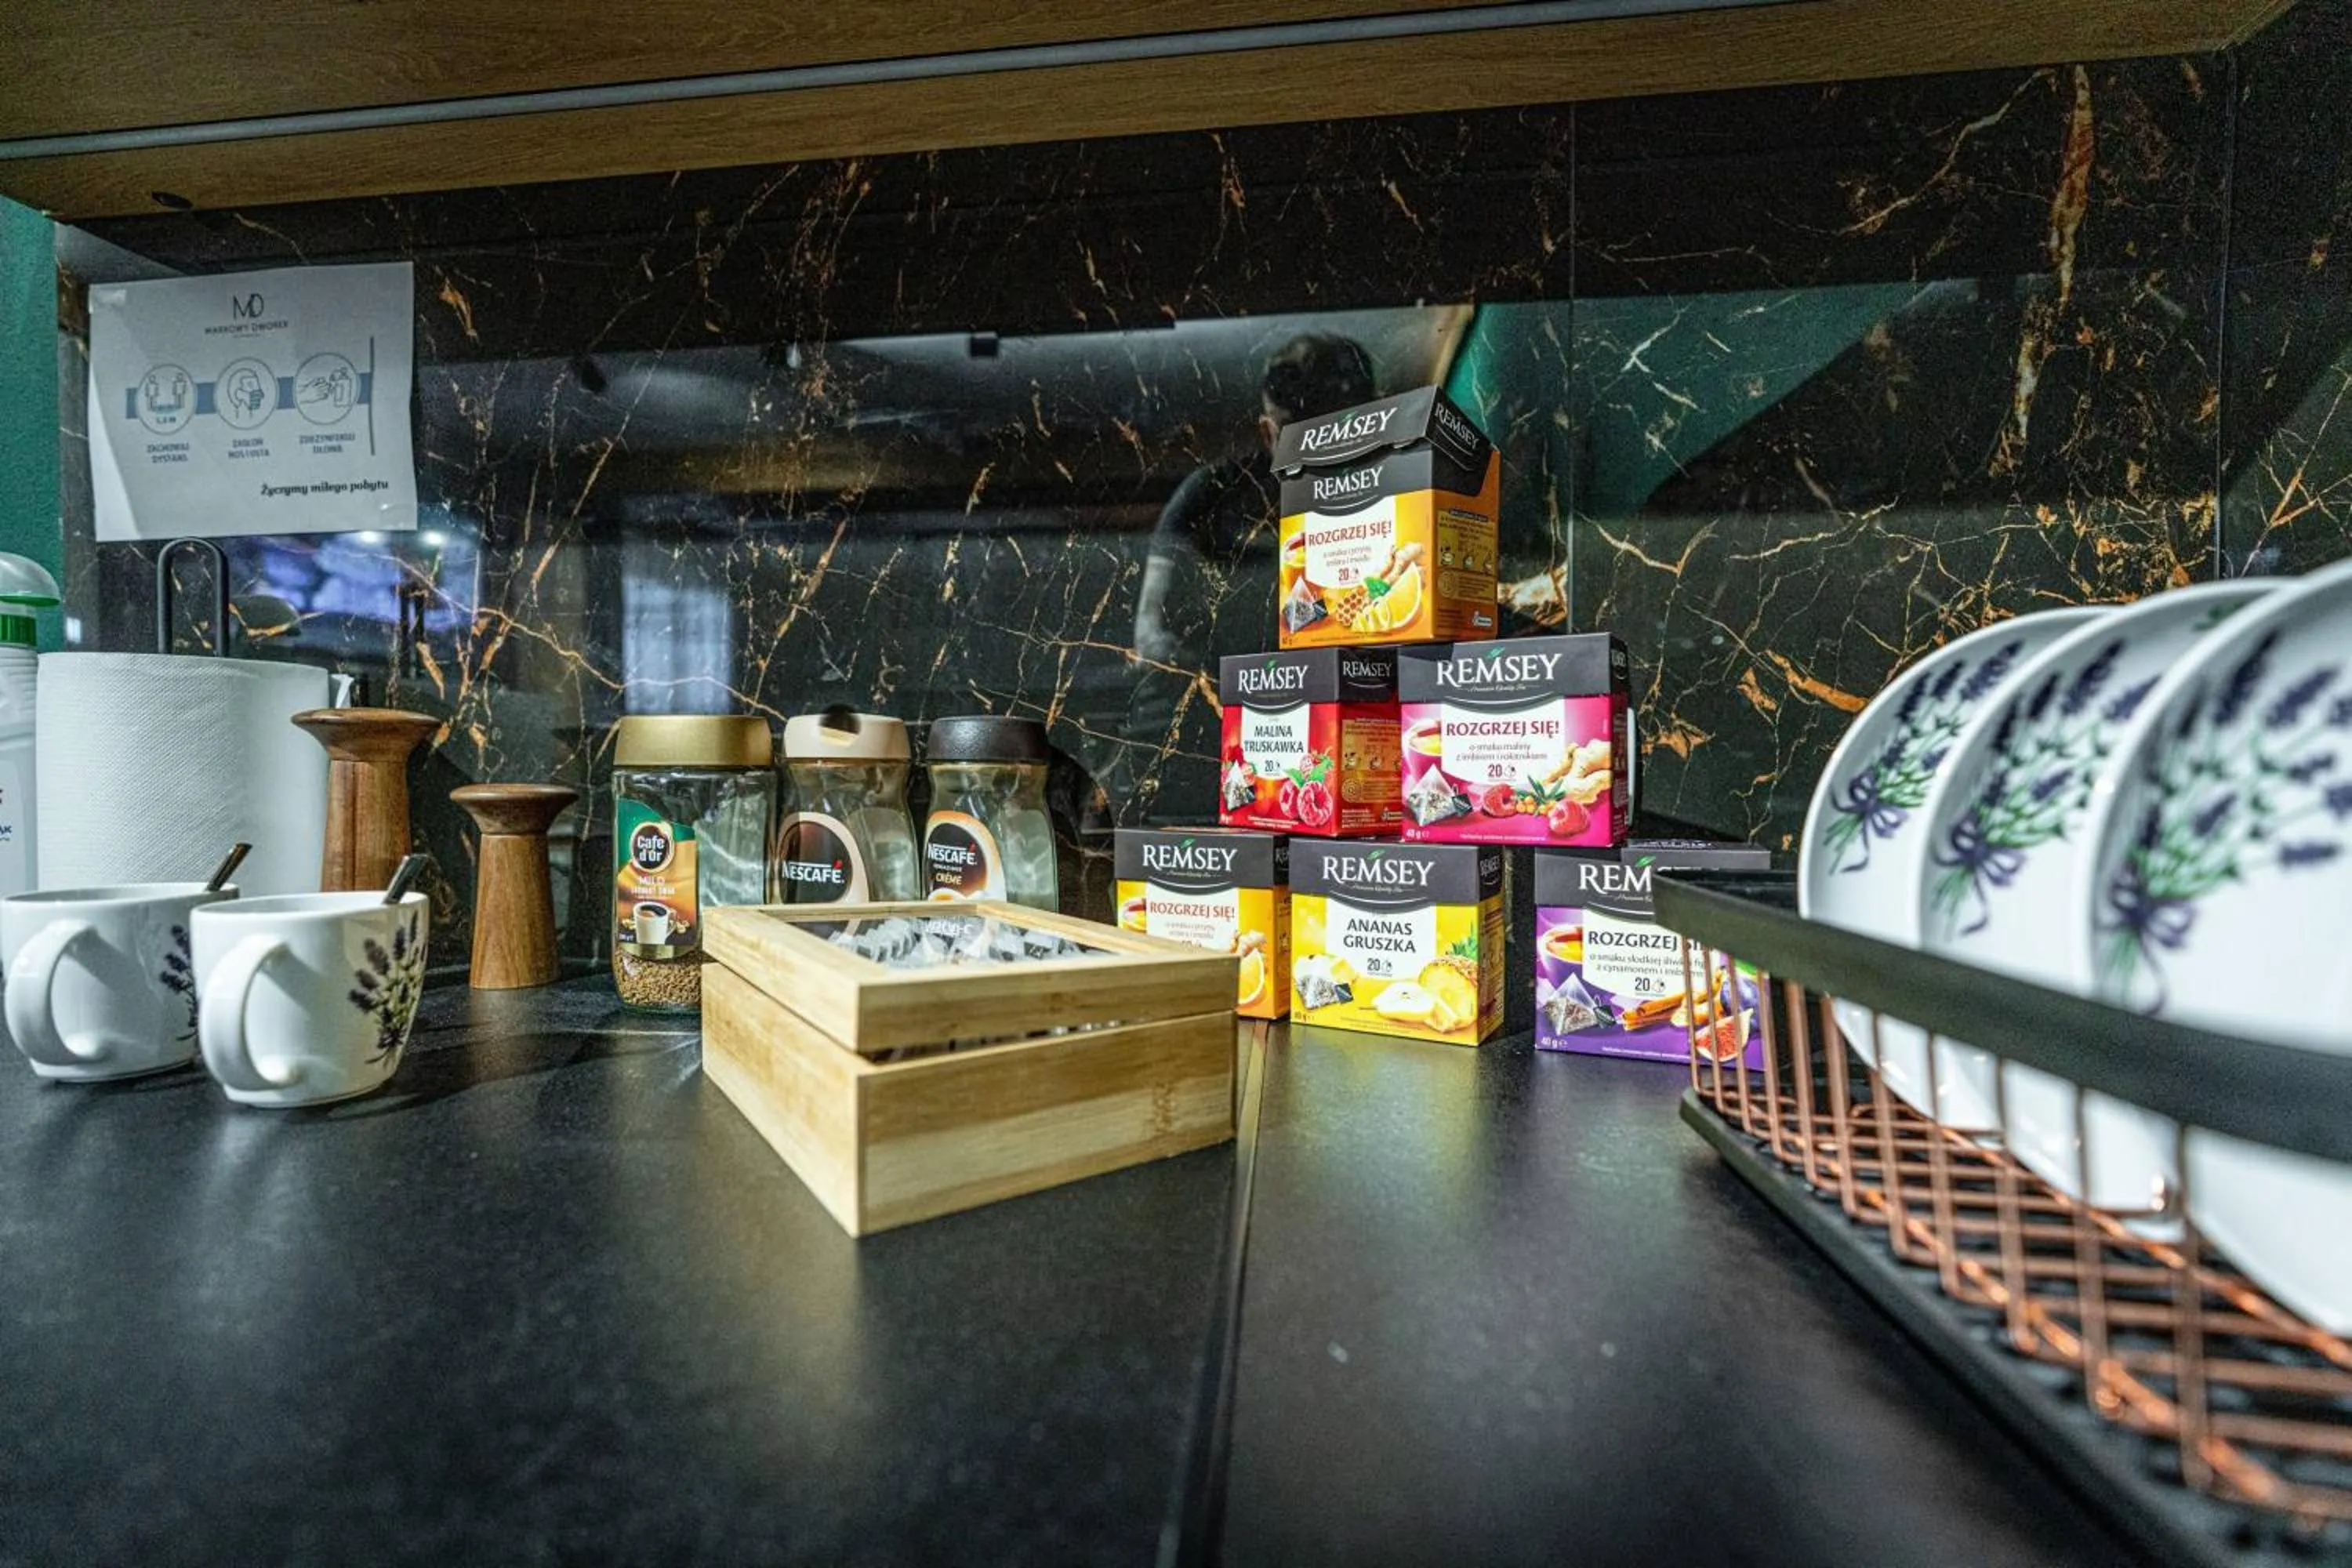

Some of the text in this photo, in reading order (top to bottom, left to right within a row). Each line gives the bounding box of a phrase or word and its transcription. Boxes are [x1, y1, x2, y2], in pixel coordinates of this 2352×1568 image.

[1299, 407, 1398, 452] REMSEY
[1434, 402, 1479, 449] REMSEY
[261, 479, 389, 497] Życzymy miłego pobytu
[1312, 466, 1383, 500] REMSEY
[1308, 520, 1392, 546] ROZGRZEJ SIĘ!
[1338, 567, 1349, 581] 20
[1341, 660, 1392, 678] REMSEY
[1436, 653, 1563, 688] REMSEY
[1238, 665, 1308, 694] REMSEY
[1254, 725, 1293, 739] MALINA
[1446, 720, 1559, 739] ROZGRZEJ SIĘ!
[1243, 740, 1305, 753] TRUSKAWKA
[1265, 760, 1274, 772] 20
[1487, 763, 1503, 779] 20
[1142, 844, 1238, 872] REMSEY
[1323, 855, 1436, 887] REMSEY
[1578, 864, 1653, 895] REM
[1149, 901, 1236, 922] ROZGRZEJ SIĘ!
[1346, 917, 1413, 935] ANANAS
[1343, 935, 1416, 953] GRUSZKA
[1588, 931, 1678, 951] ROZGRZEJ
[1367, 958, 1381, 971] 20
[1598, 953, 1625, 961] smaku
[1635, 977, 1650, 992] 20
